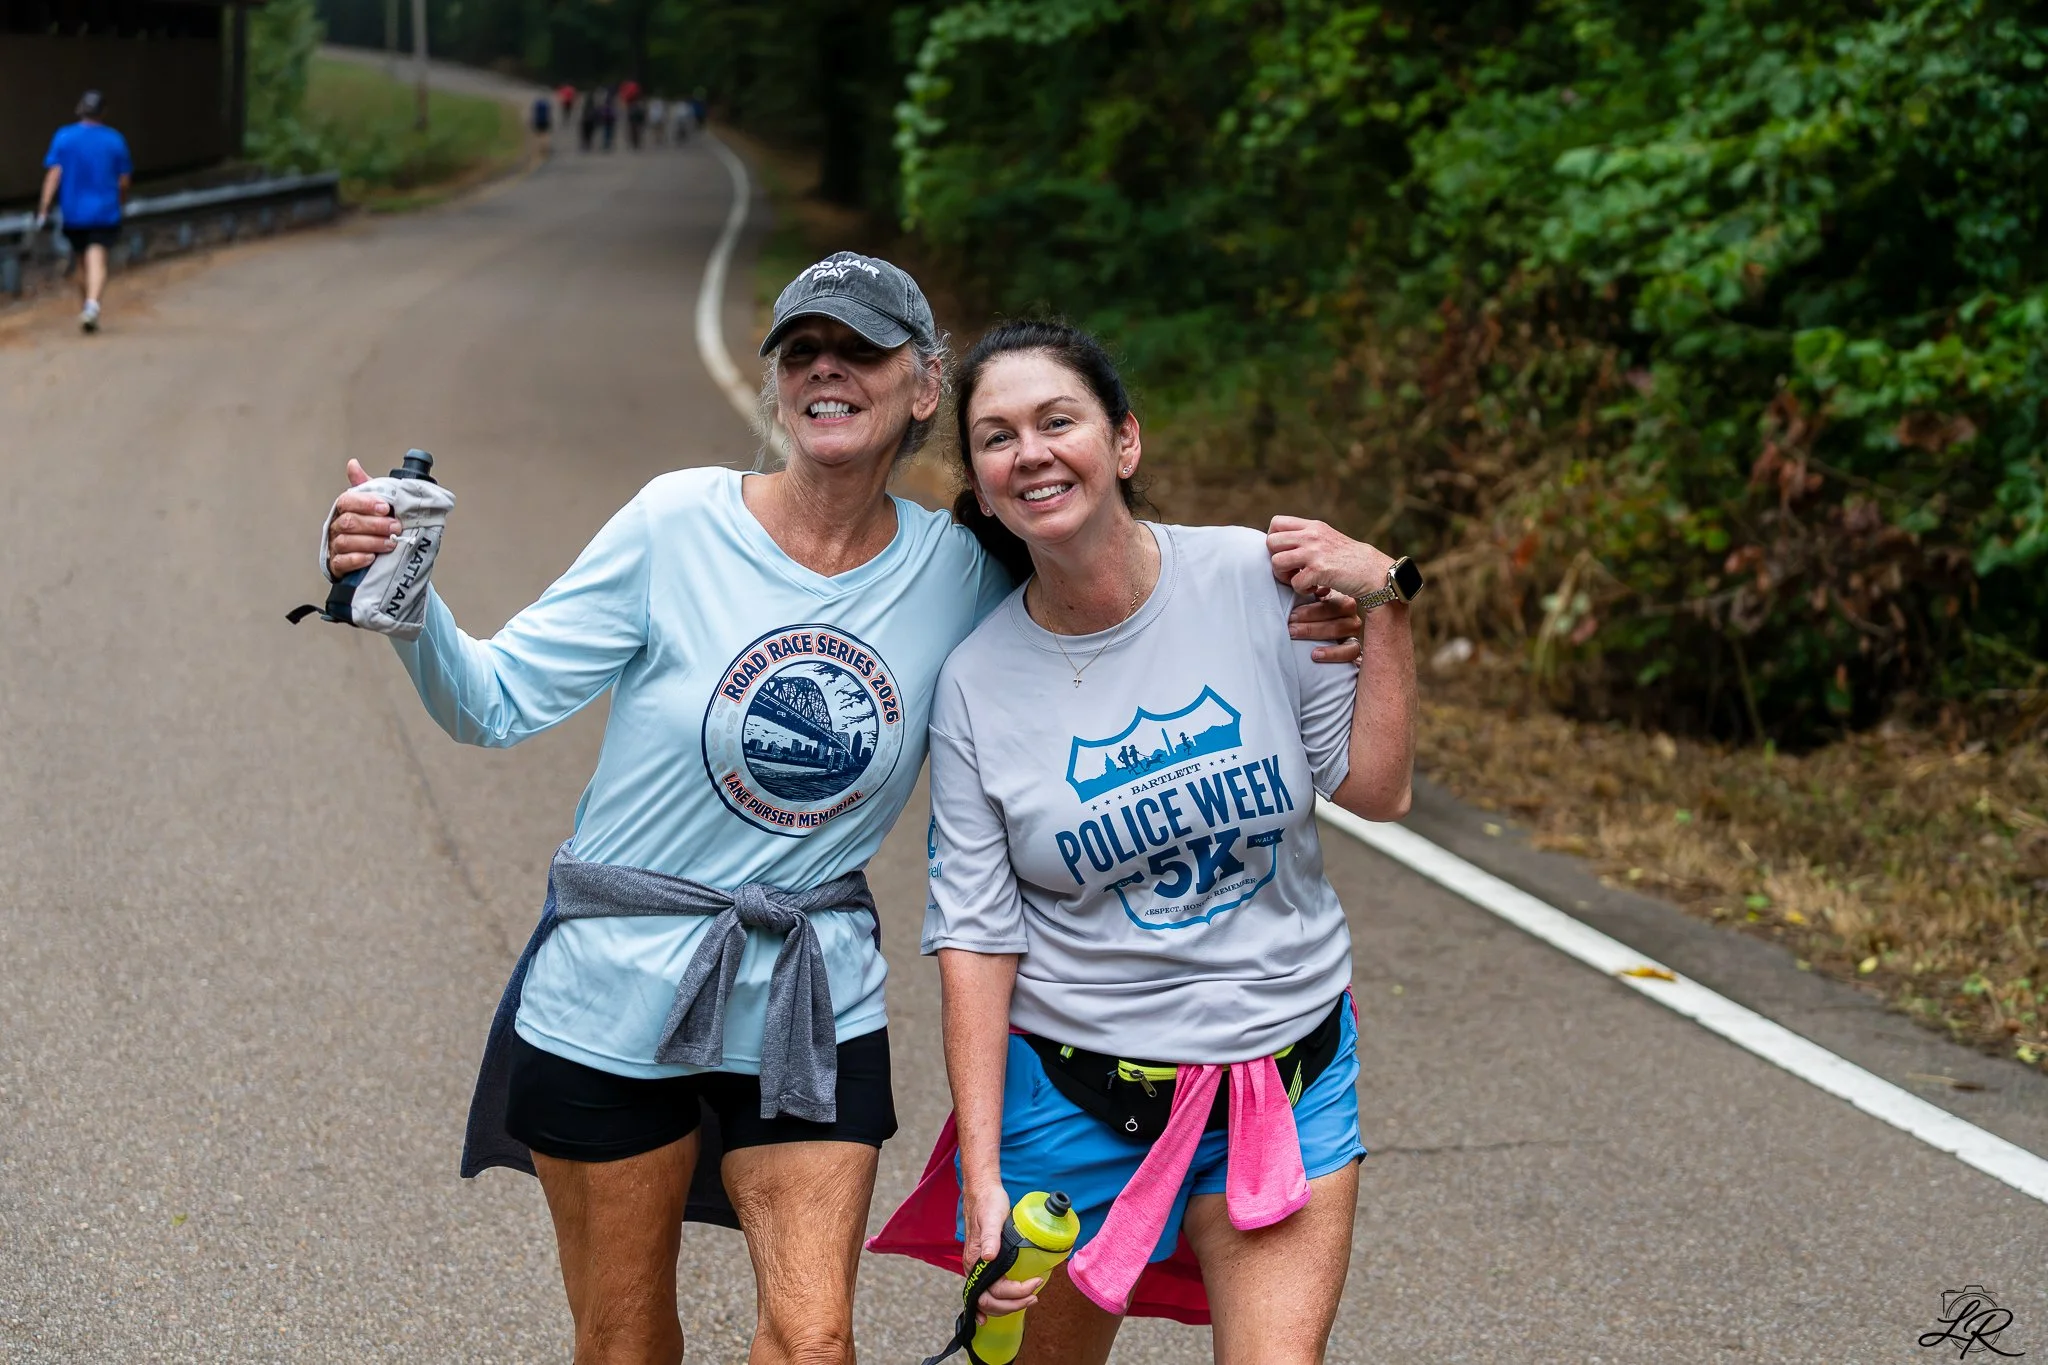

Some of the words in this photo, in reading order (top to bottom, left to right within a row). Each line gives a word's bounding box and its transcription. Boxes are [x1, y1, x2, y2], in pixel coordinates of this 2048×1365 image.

[812, 267, 851, 281] DAY
[835, 258, 880, 279] HAIR
[386, 536, 432, 618] NATHAN
[721, 650, 769, 703] ROAD
[764, 633, 813, 663] RACE
[816, 633, 877, 679] SERIES
[869, 672, 900, 724] 2026
[722, 772, 752, 805] LANE
[744, 795, 796, 827] PURSER
[797, 790, 864, 828] MEMORIAL
[1130, 762, 1201, 795] BARTLETT
[1055, 787, 1192, 886] POLICE
[1185, 754, 1294, 828] WEEK
[1255, 835, 1274, 843] WALK
[1148, 827, 1245, 898] 5K
[1144, 905, 1182, 916] RESPECT.
